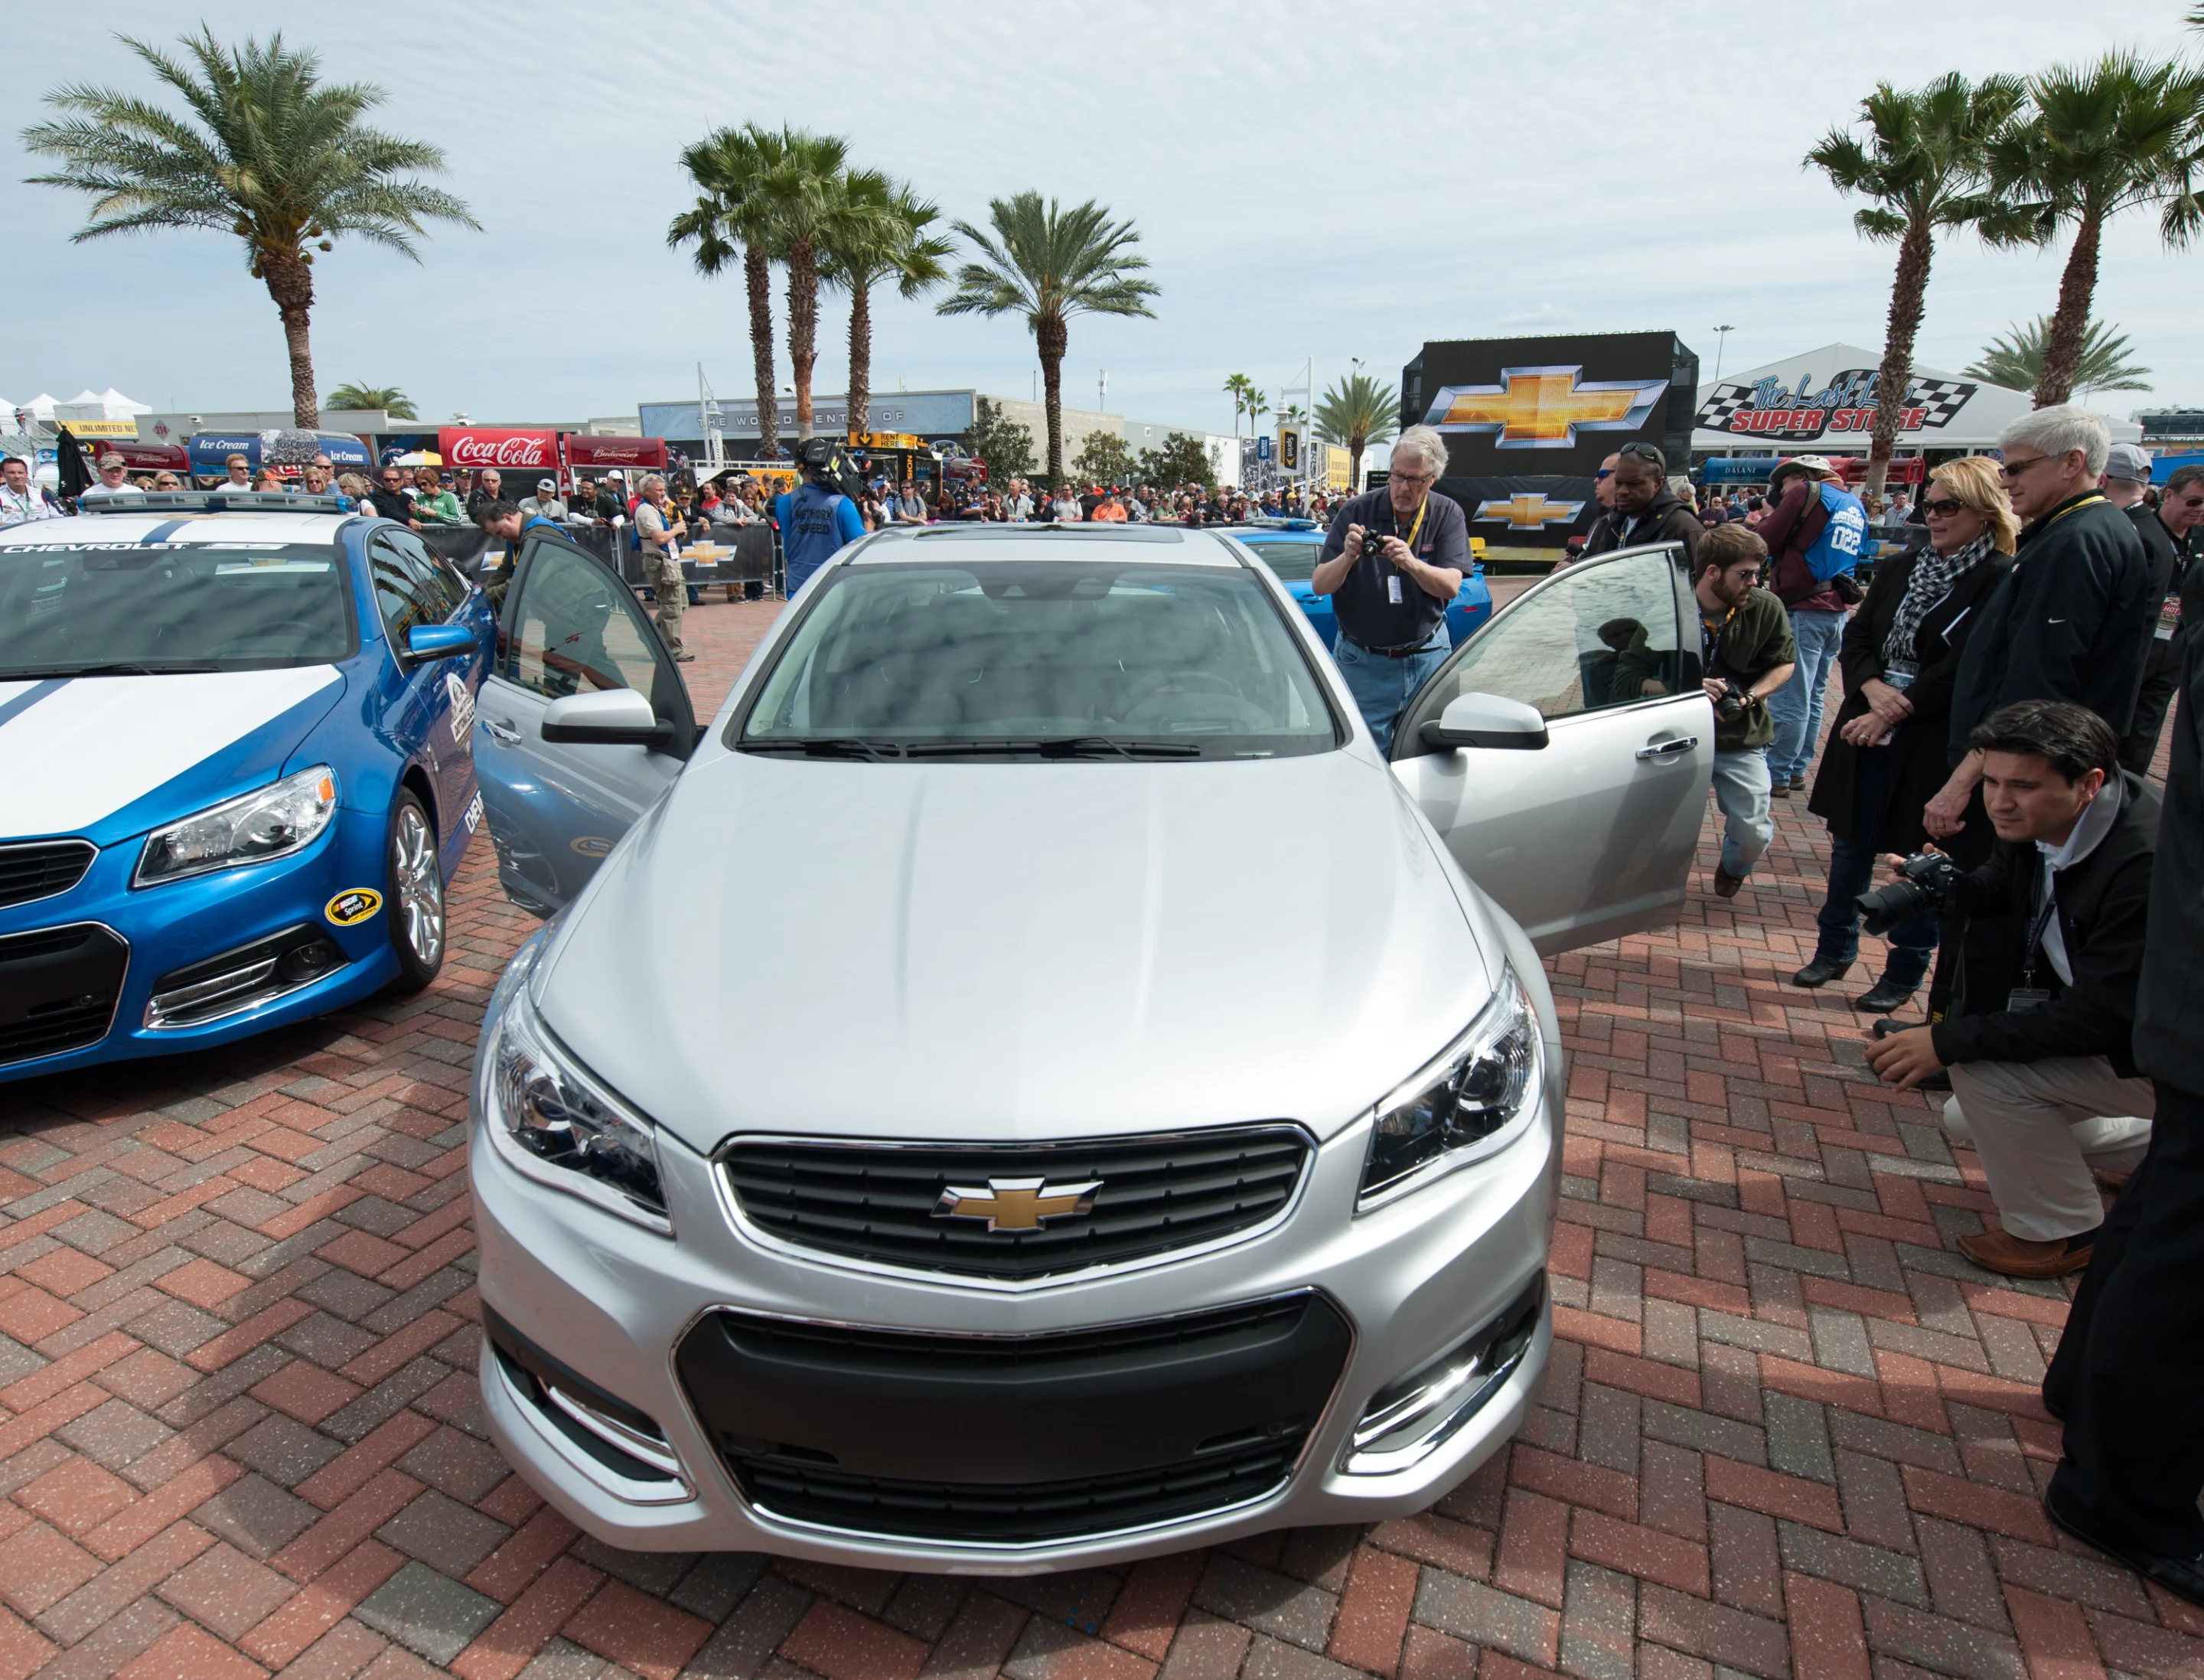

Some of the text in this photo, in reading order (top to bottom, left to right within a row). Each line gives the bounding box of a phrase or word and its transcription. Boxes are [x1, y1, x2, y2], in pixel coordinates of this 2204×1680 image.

[1752, 374, 1789, 409] The
[1790, 374, 1856, 409] Last
[698, 418, 726, 426] THE
[882, 412, 903, 421] OF
[1730, 409, 1824, 431] SUPER
[155, 426, 167, 434] 214
[200, 439, 249, 450] Ice Cream
[452, 436, 546, 465] Coca-Cola
[331, 450, 364, 462] Ice Cream
[592, 449, 639, 458] Budweiser
[795, 507, 833, 520] NETWORK
[1831, 526, 1860, 556] 022
[3, 543, 187, 553] CHEVROLET
[2163, 605, 2180, 614] HOT
[344, 902, 364, 916] Sprint
